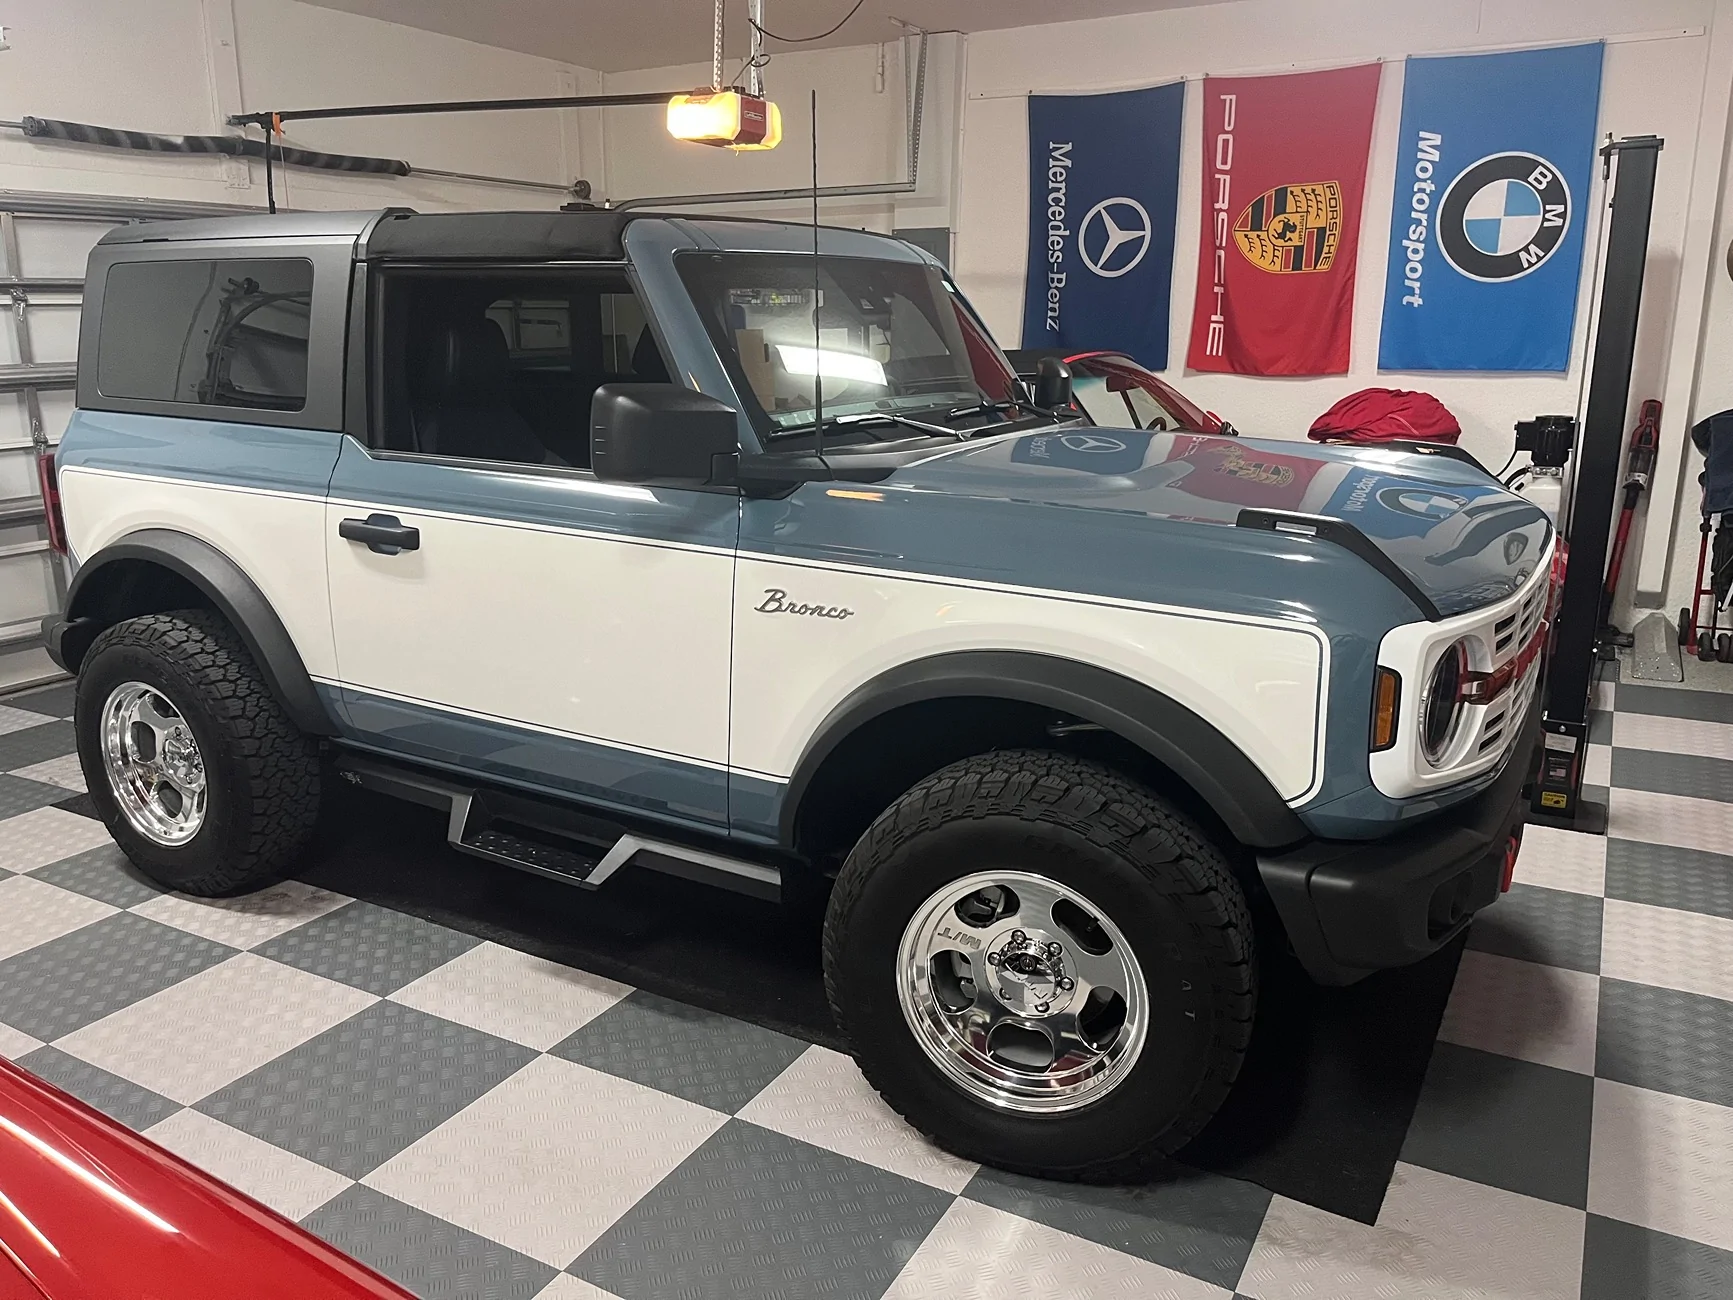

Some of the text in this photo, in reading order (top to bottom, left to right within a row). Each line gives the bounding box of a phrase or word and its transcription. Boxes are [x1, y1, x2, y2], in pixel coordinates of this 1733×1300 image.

[1046, 141, 1073, 332] Mercedes-Benz
[1206, 94, 1236, 356] PORSCHE
[1319, 185, 1339, 267] PORSCHE
[1402, 131, 1442, 307] Motorsport
[1518, 165, 1565, 269] BMW
[754, 588, 855, 620] Bronco
[937, 927, 982, 949] M/T
